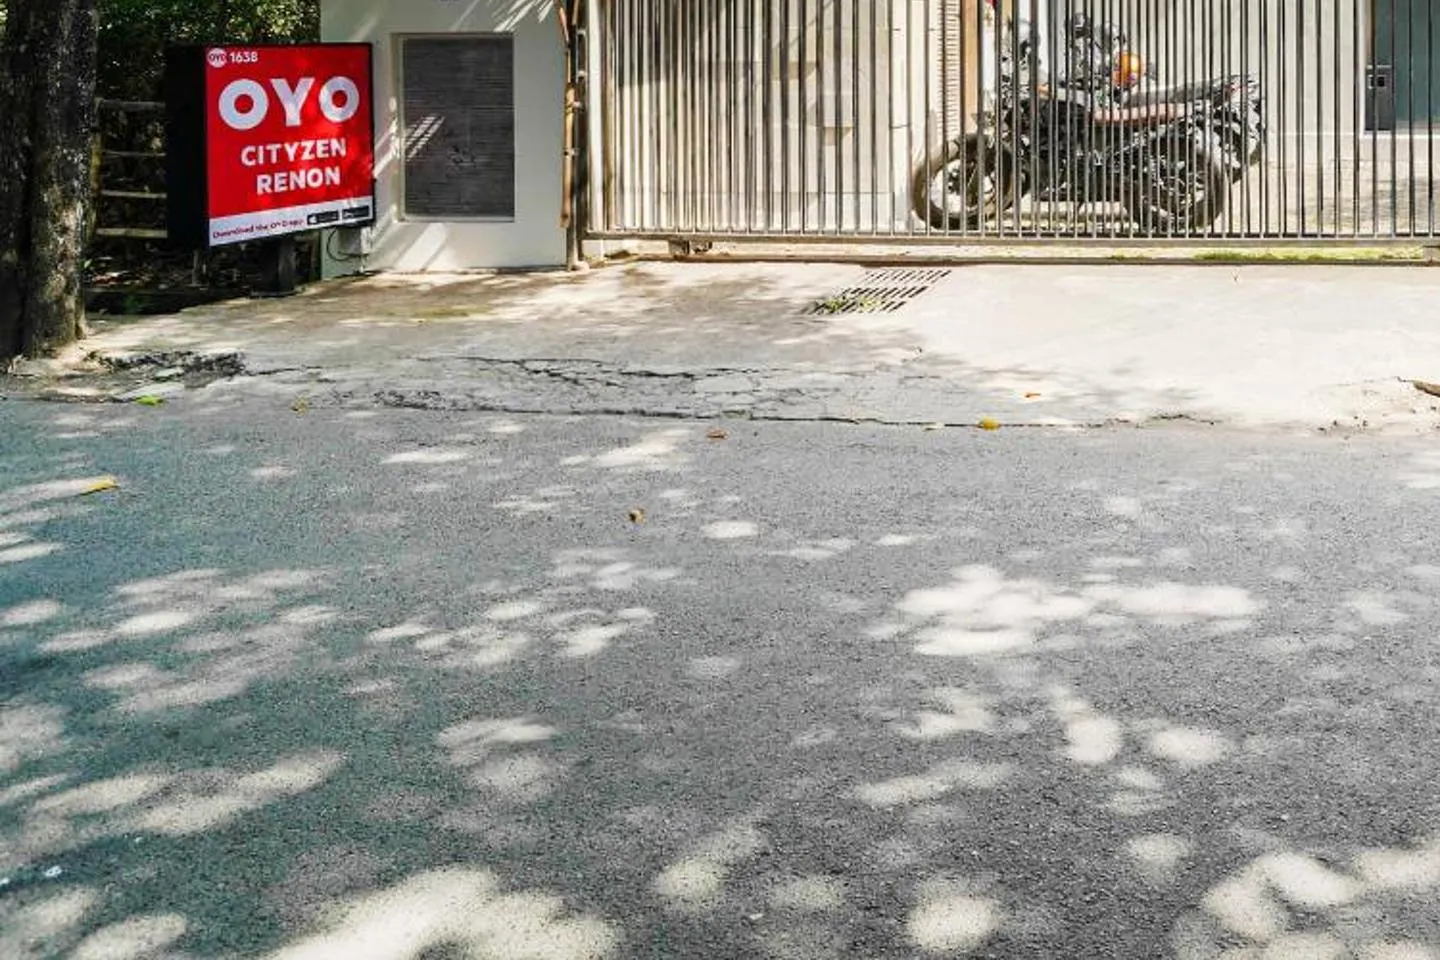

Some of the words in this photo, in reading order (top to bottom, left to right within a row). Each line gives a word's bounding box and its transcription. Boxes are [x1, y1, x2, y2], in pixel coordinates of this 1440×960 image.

[229, 50, 259, 64] 1638
[218, 75, 360, 131] OYO
[240, 137, 347, 167] CITYZEN
[255, 165, 341, 195] RENON
